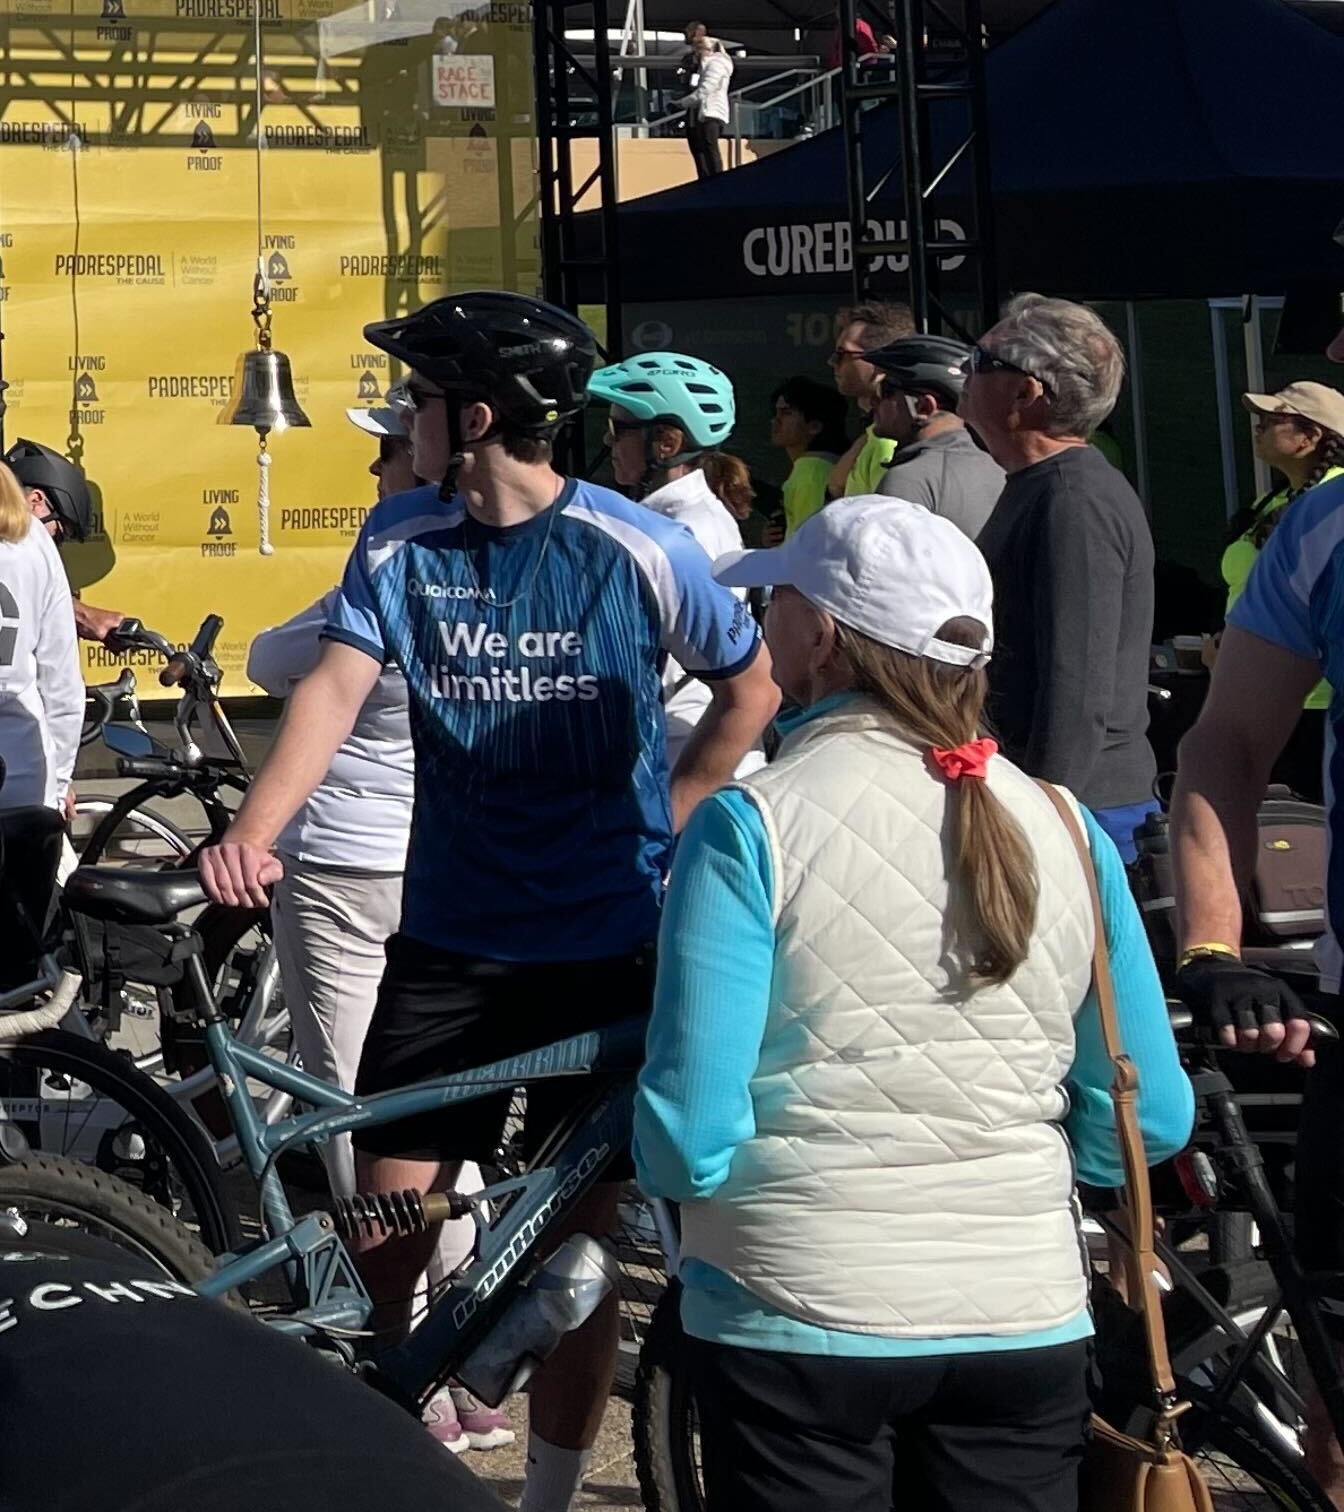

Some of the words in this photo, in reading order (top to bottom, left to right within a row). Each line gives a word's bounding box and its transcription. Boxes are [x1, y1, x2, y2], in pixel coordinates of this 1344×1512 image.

[97, 26, 133, 41] PROOF
[437, 65, 477, 82] RACE
[185, 103, 222, 119] LIVING
[0, 121, 90, 145] DRESPEDAL
[265, 125, 371, 147] PADRESPEDAL
[187, 156, 223, 171] PROOF
[743, 219, 966, 276] CUREBOUD
[56, 254, 165, 276] PADRESPEDAL
[181, 256, 189, 264] A
[191, 255, 217, 265] World
[340, 255, 442, 276] PADRESPEDAL
[268, 288, 299, 302] ROOF
[68, 356, 106, 371] LIVING
[351, 354, 386, 369] LIVING
[661, 367, 696, 378] GIRO
[148, 375, 235, 397] PADRESPE
[69, 410, 106, 425] PROOF
[203, 489, 239, 505] LIVING
[123, 513, 131, 521] A
[133, 512, 160, 522] World
[281, 507, 368, 530] PADRESPED
[123, 522, 159, 532] Without
[122, 532, 155, 542] Cancer
[201, 543, 238, 558] PROOF
[438, 620, 509, 658] We
[518, 631, 583, 658] are
[431, 665, 600, 702] limitless
